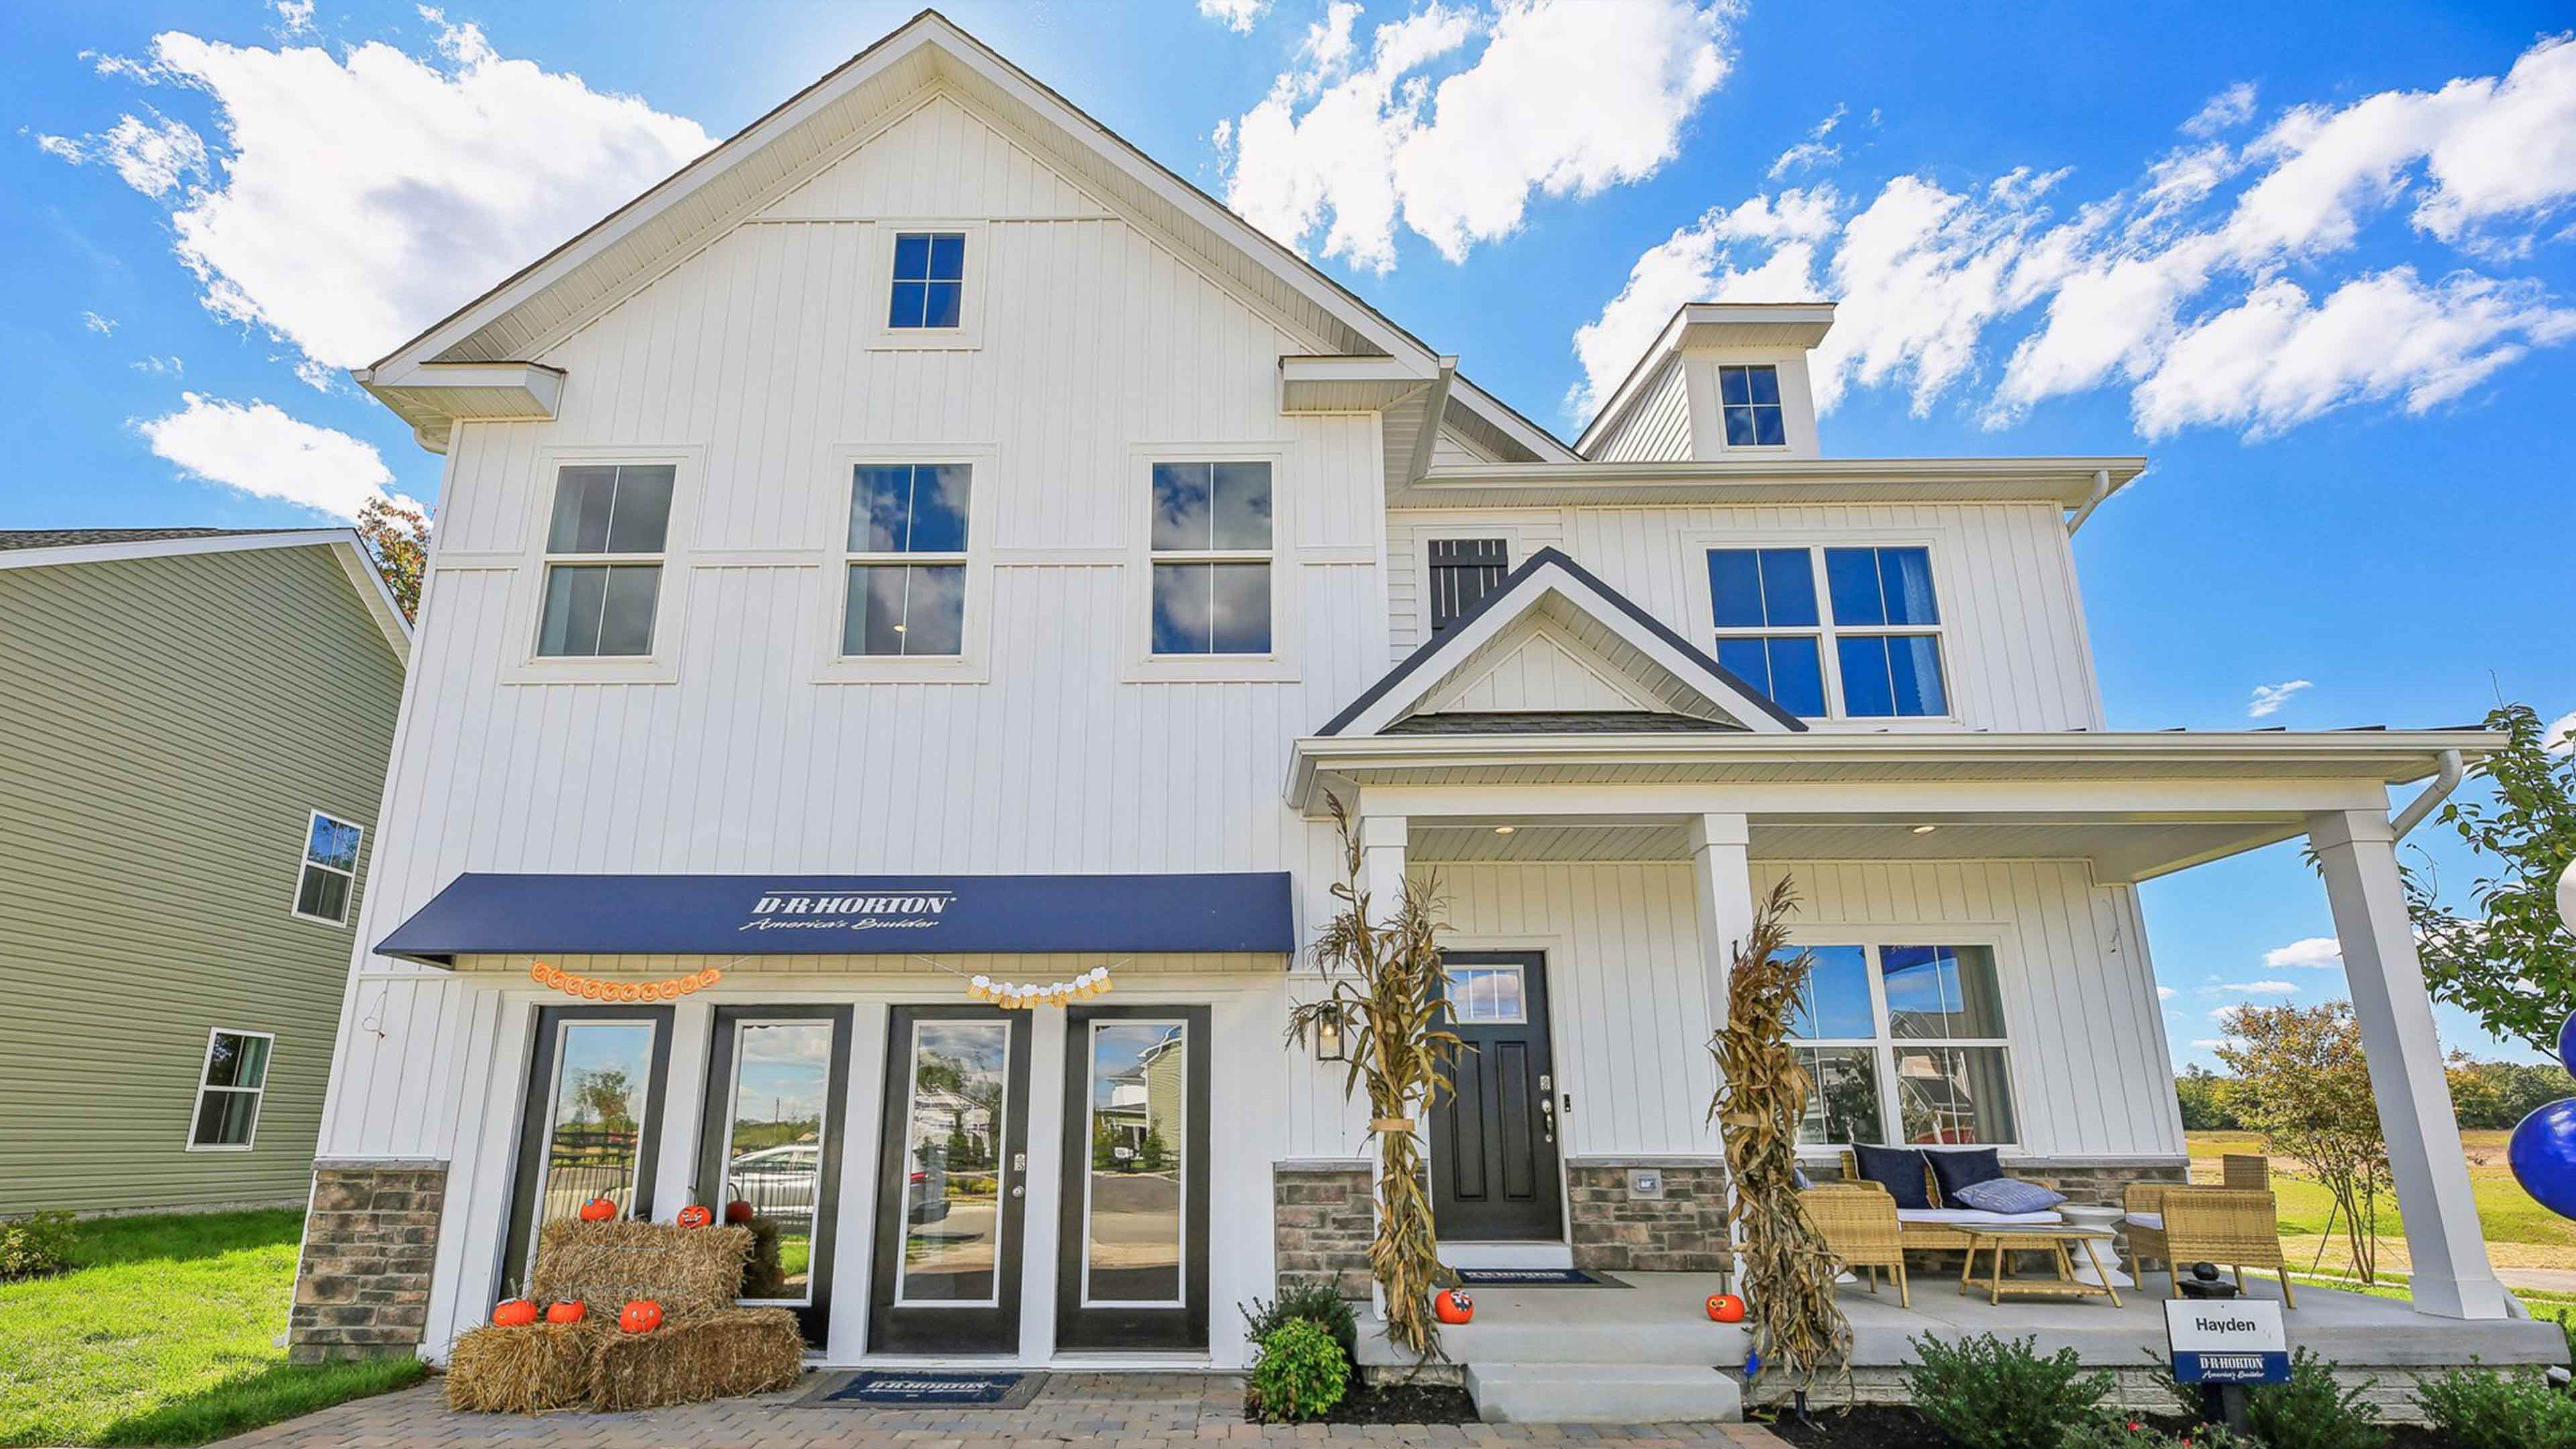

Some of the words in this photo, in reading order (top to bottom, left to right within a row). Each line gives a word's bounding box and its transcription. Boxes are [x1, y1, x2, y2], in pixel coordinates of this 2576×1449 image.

[739, 917, 849, 930] America's
[851, 917, 940, 930] Builder
[2195, 1317, 2256, 1334] Hayden
